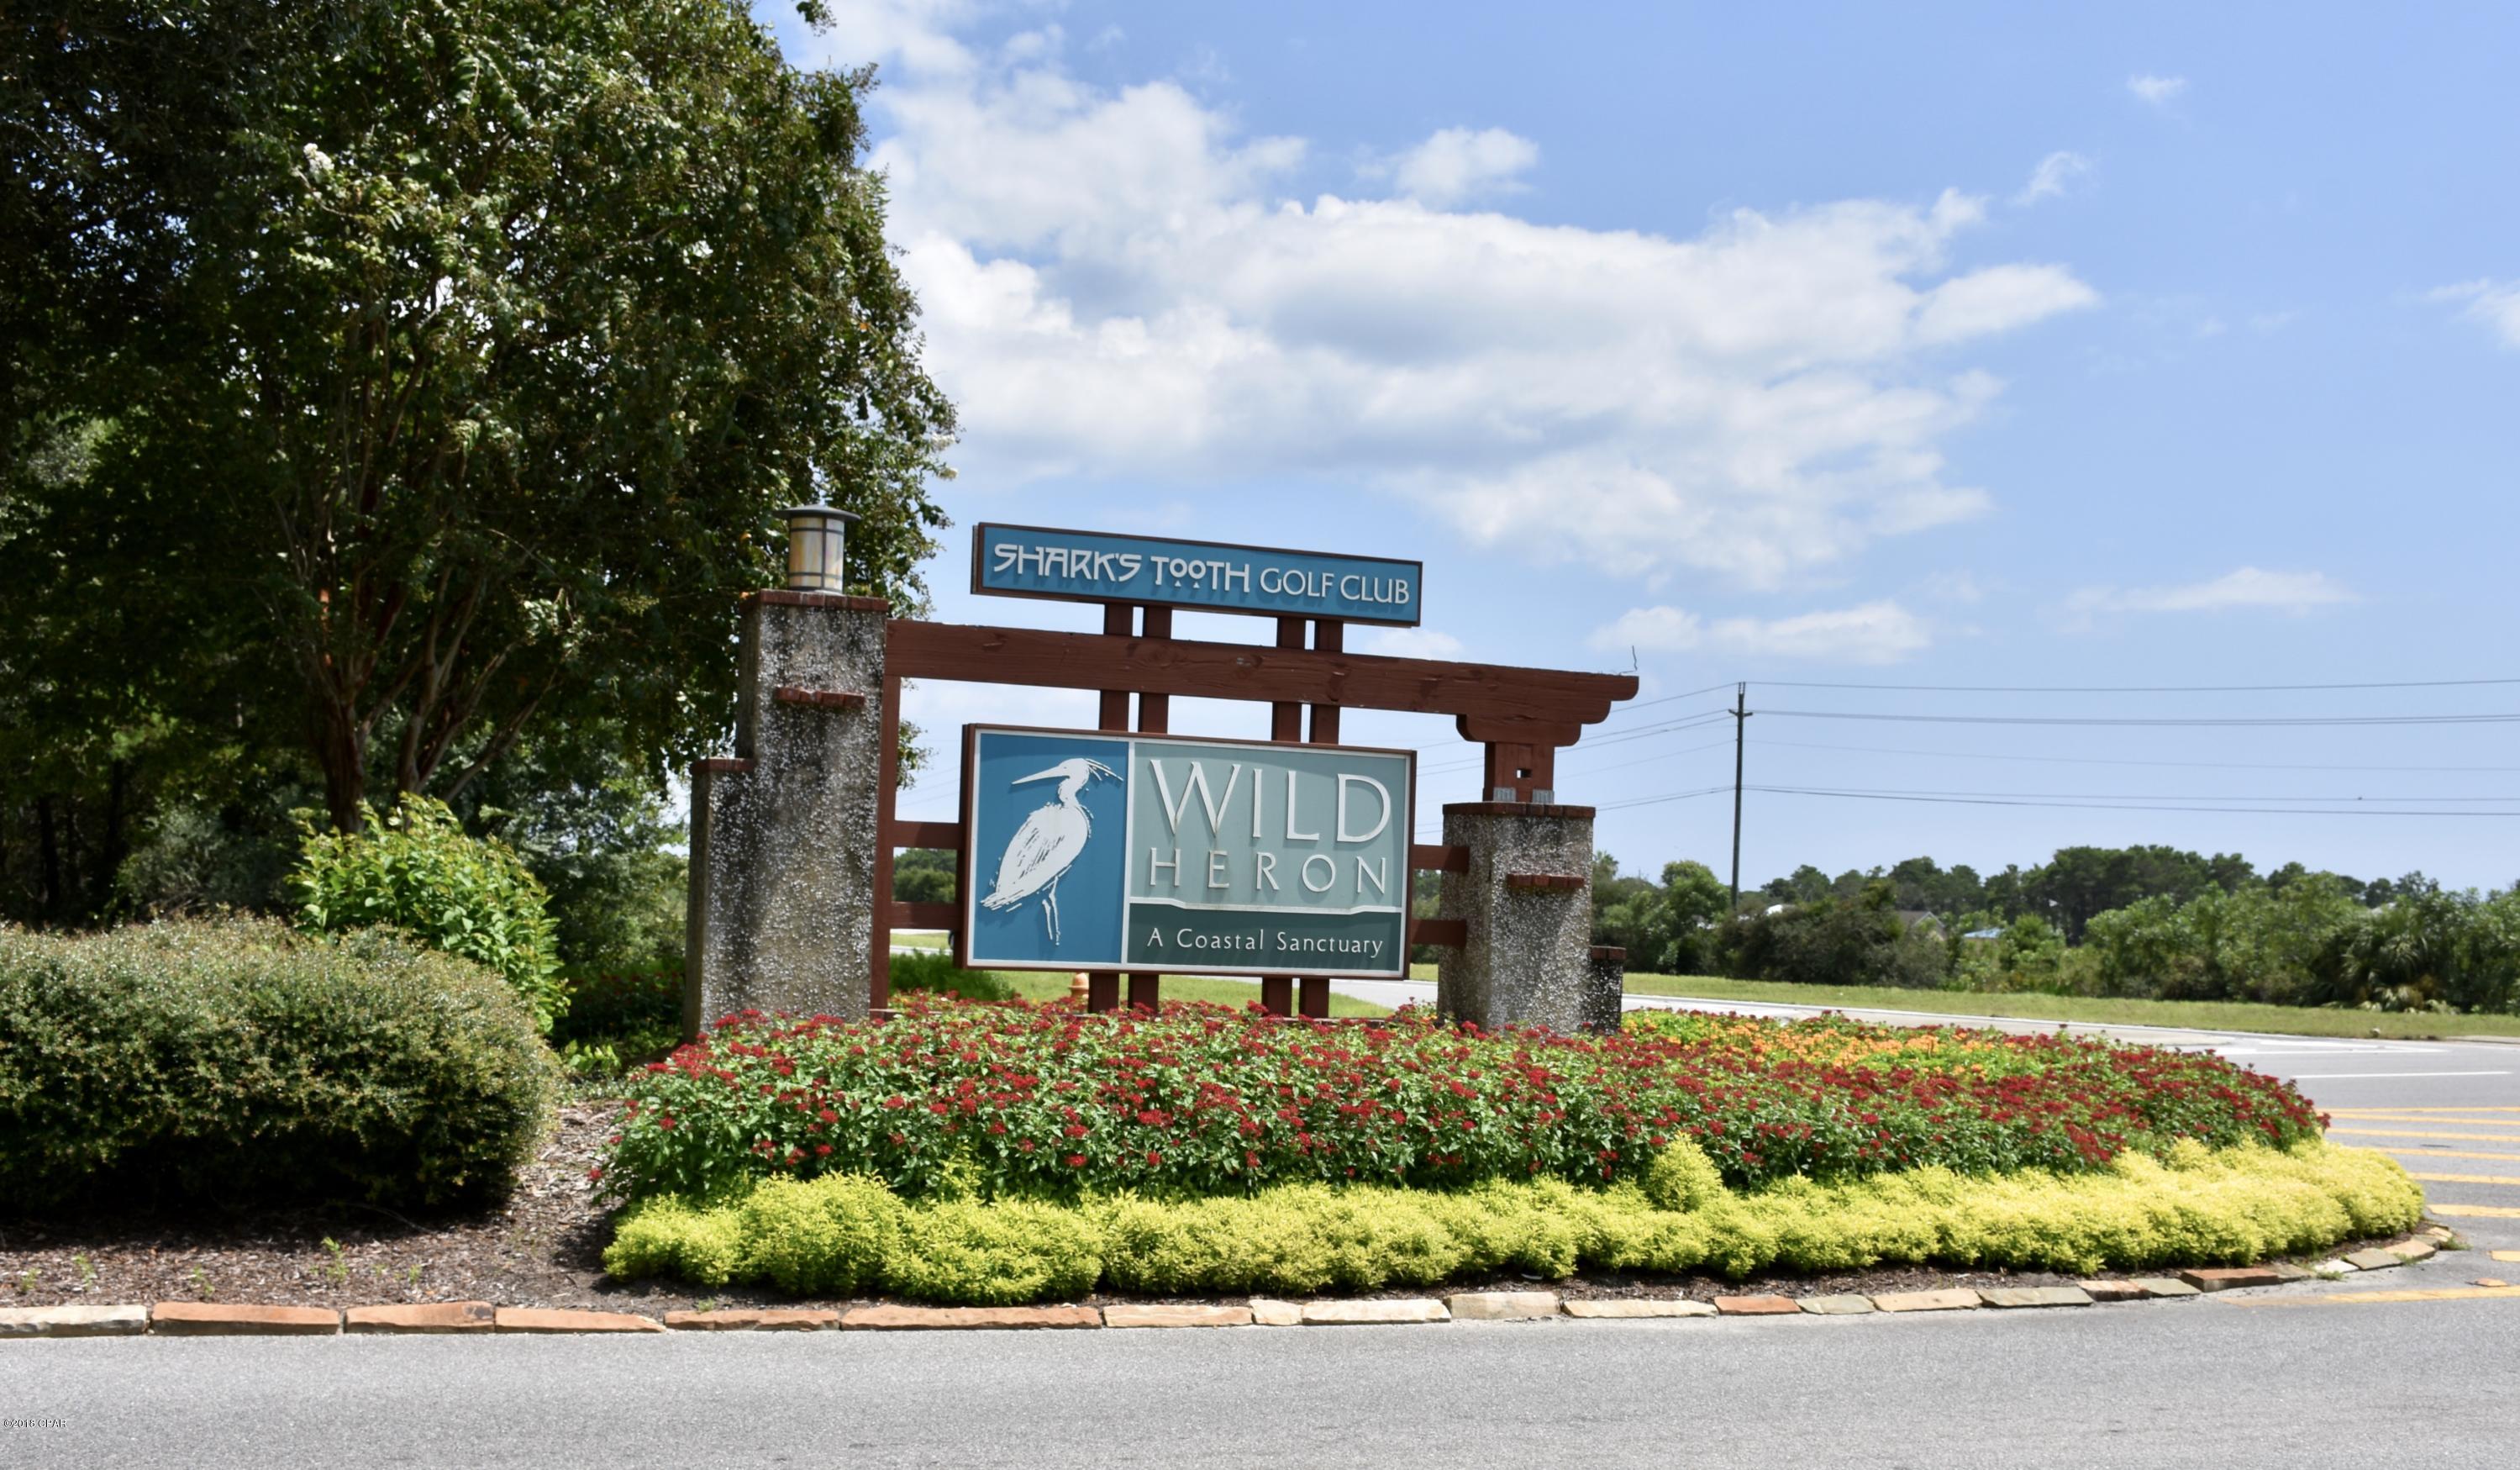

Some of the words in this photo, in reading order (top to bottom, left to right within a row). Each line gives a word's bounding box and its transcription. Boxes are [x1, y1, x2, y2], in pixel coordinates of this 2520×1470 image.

[993, 544, 1142, 582] SHARK'S
[1150, 556, 1250, 593] TOOTH
[1260, 567, 1334, 598] GOLF
[1340, 575, 1410, 604] CLUB
[1150, 759, 1392, 843] WILD
[1150, 847, 1386, 895] HERON
[1147, 927, 1163, 947] A
[1176, 928, 1264, 951] Coastal
[1276, 931, 1383, 958] Sanctuary
